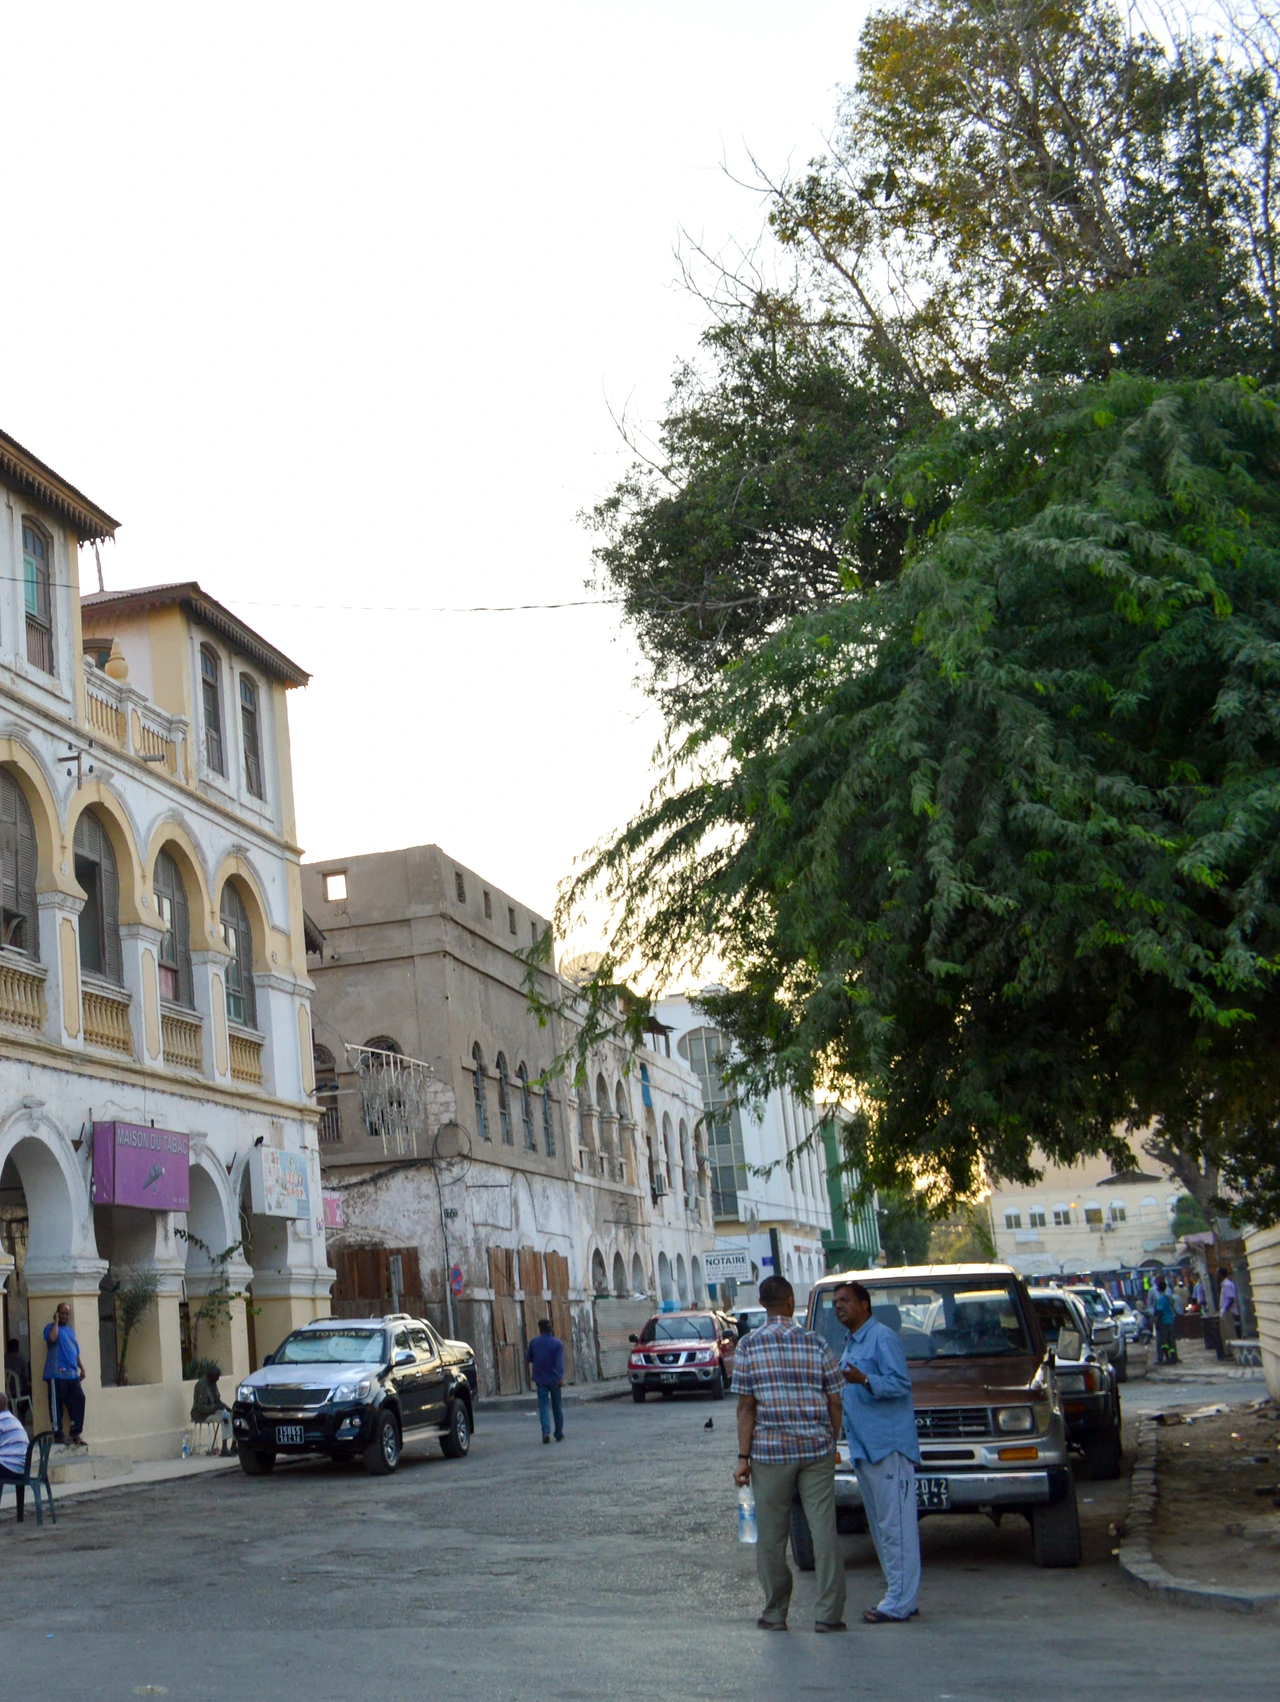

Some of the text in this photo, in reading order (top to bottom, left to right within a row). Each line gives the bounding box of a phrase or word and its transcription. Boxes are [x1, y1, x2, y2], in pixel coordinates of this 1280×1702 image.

[117, 1128, 188, 1155] MAISON DU TABAC
[705, 1256, 747, 1266] NOTAIRE
